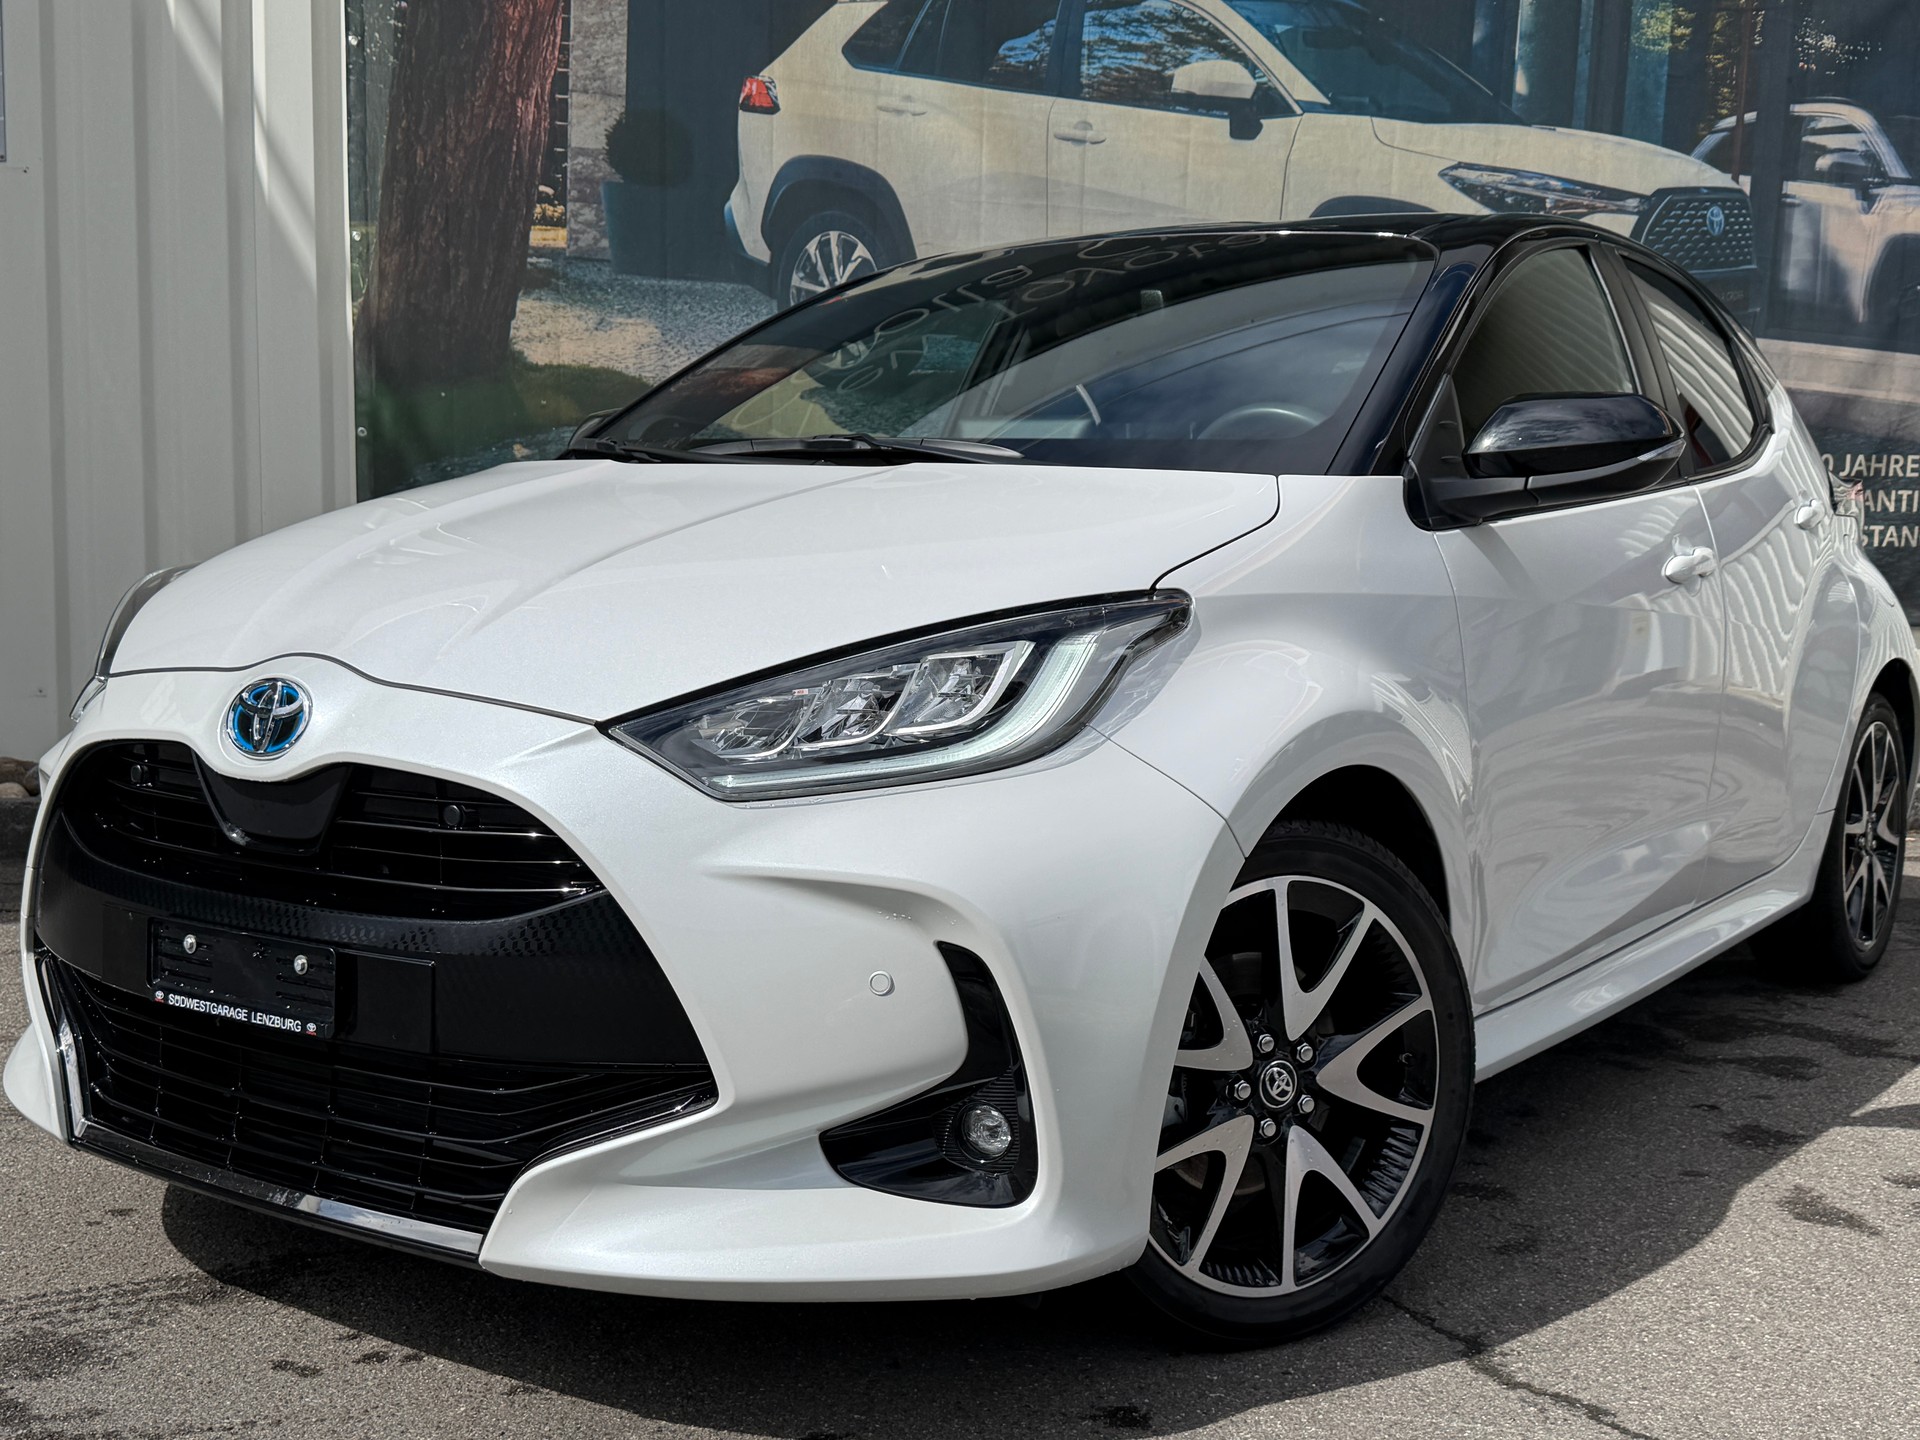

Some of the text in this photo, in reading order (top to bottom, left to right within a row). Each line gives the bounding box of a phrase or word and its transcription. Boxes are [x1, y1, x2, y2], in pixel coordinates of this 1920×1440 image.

[1839, 453, 1920, 477] JAHRE
[168, 993, 302, 1033] SÜDWESTGARAGE LENZBURG
